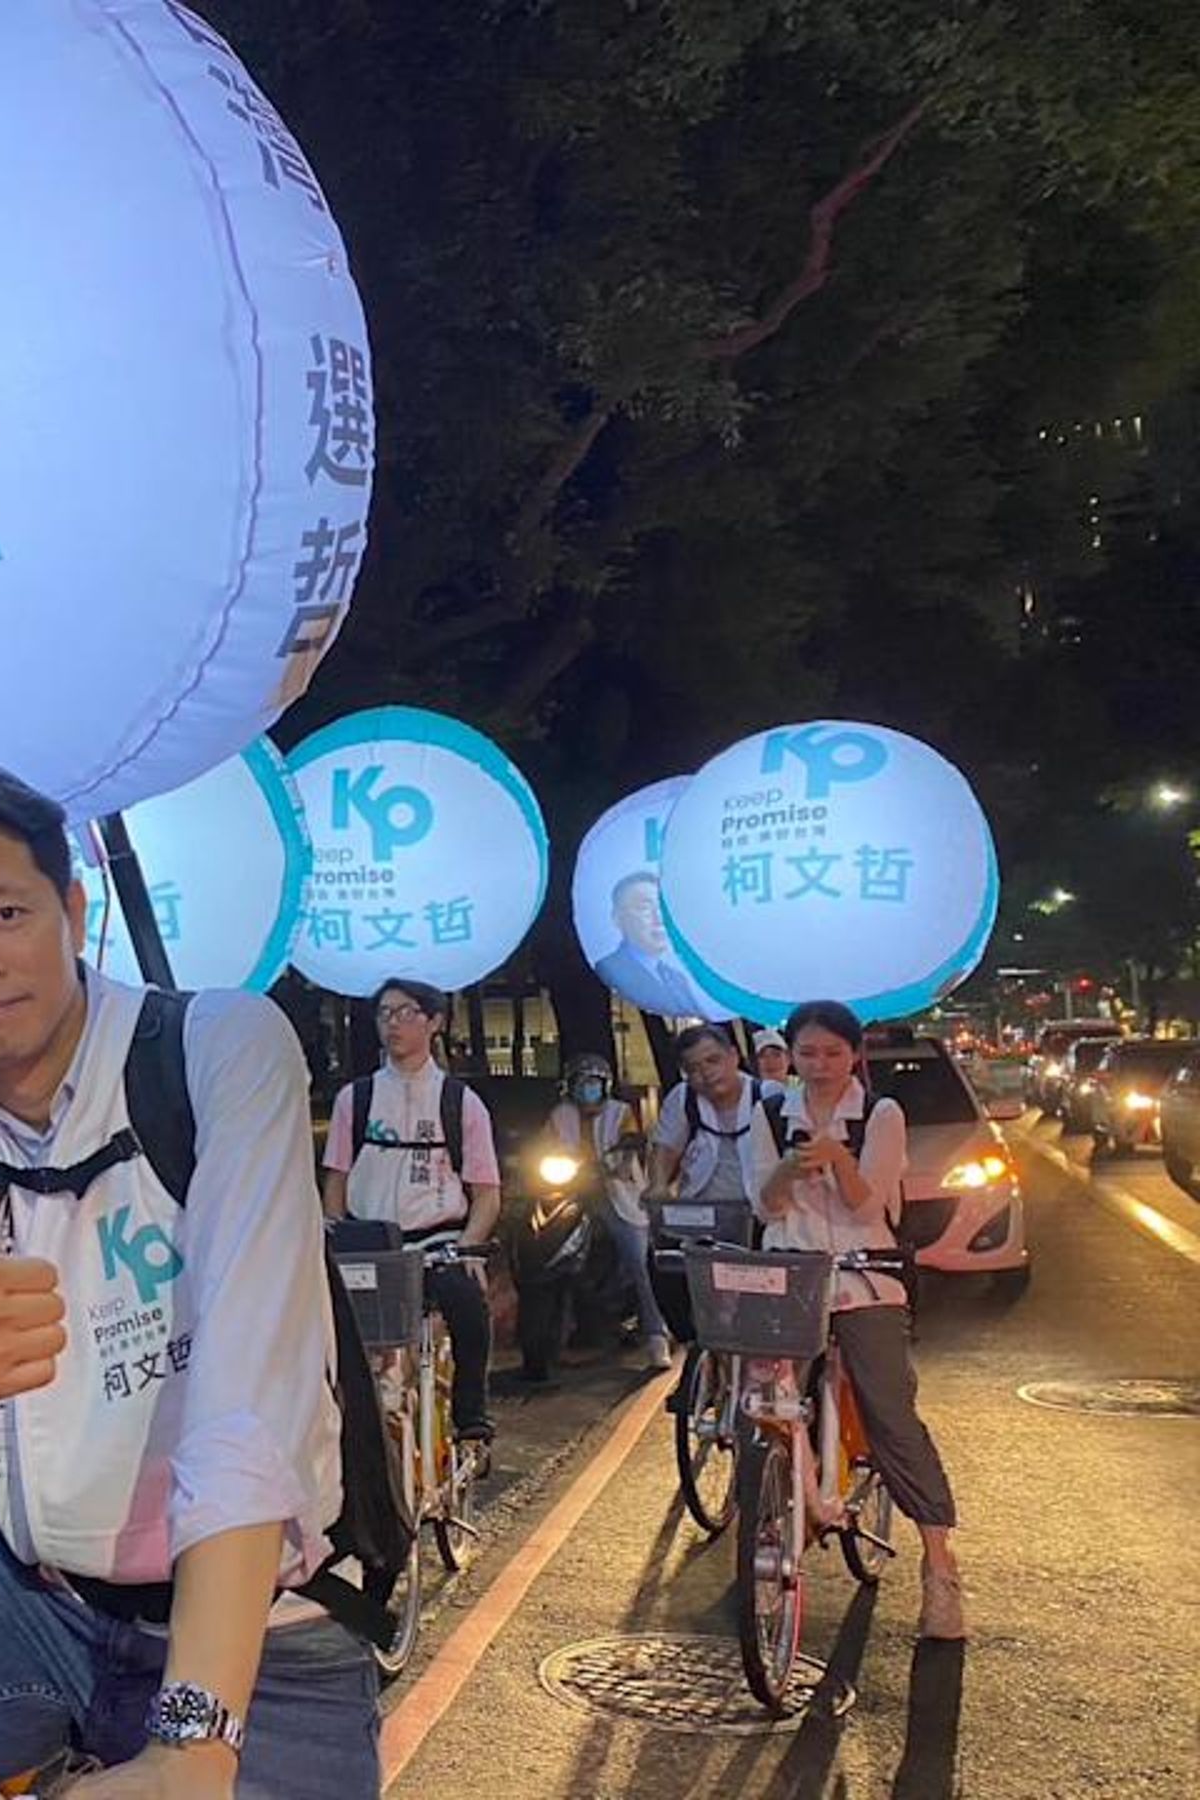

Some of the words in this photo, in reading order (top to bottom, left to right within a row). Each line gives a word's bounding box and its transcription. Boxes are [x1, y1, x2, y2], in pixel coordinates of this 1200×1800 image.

[721, 803, 828, 835] Promise
[313, 847, 353, 865] eep
[313, 865, 394, 885] romise
[721, 844, 915, 907] 柯文哲
[301, 896, 475, 951] 柯文哲
